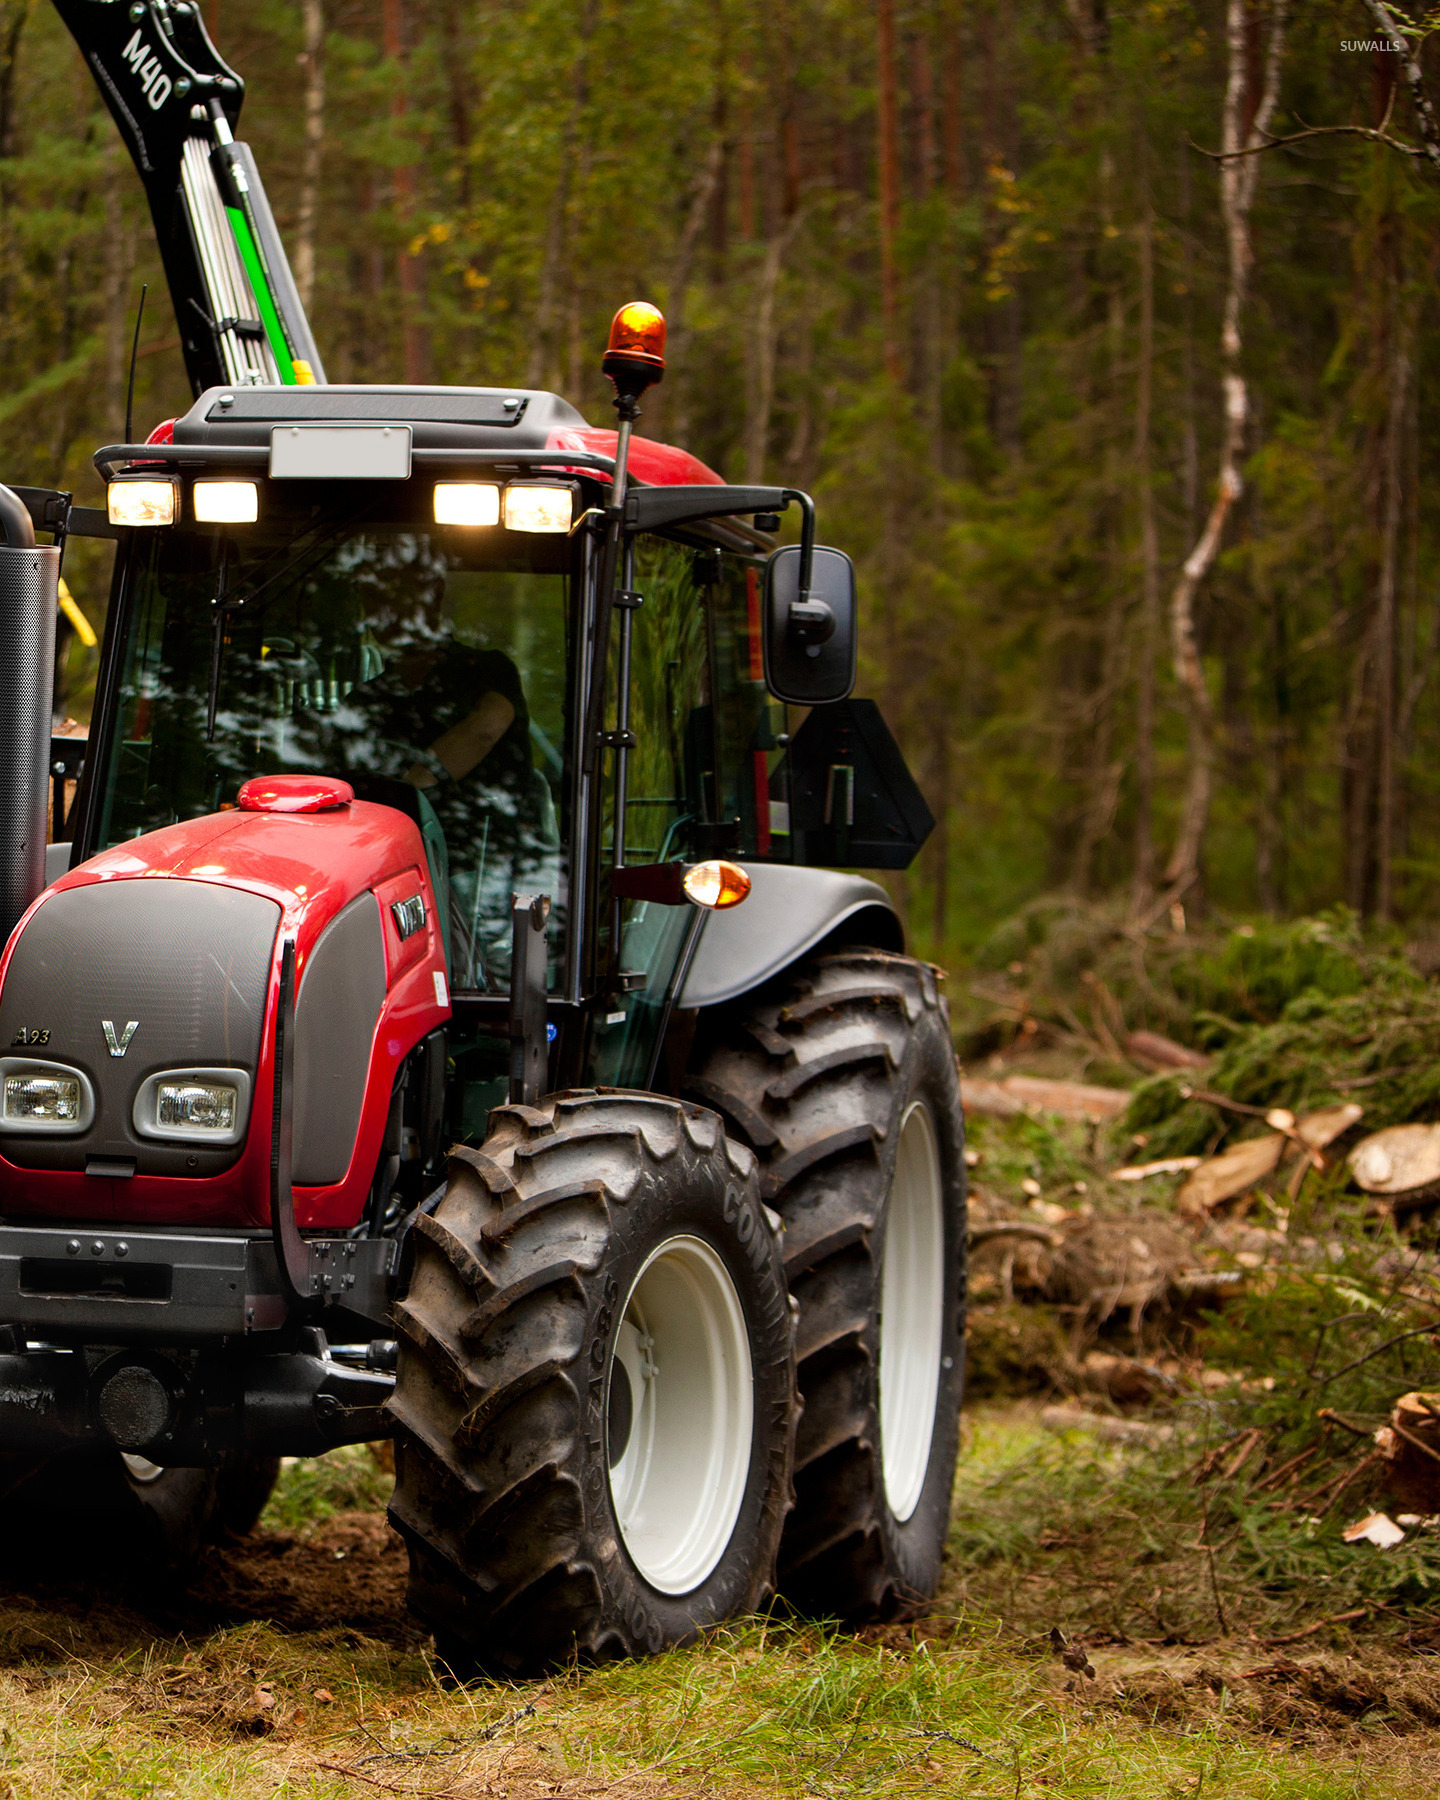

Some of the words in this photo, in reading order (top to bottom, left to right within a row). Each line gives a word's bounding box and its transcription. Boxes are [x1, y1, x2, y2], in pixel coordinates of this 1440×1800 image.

[121, 28, 172, 110] M40
[101, 1020, 140, 1057] V
[587, 1273, 619, 1404] AC85
[583, 1431, 664, 1654] CONTACT
